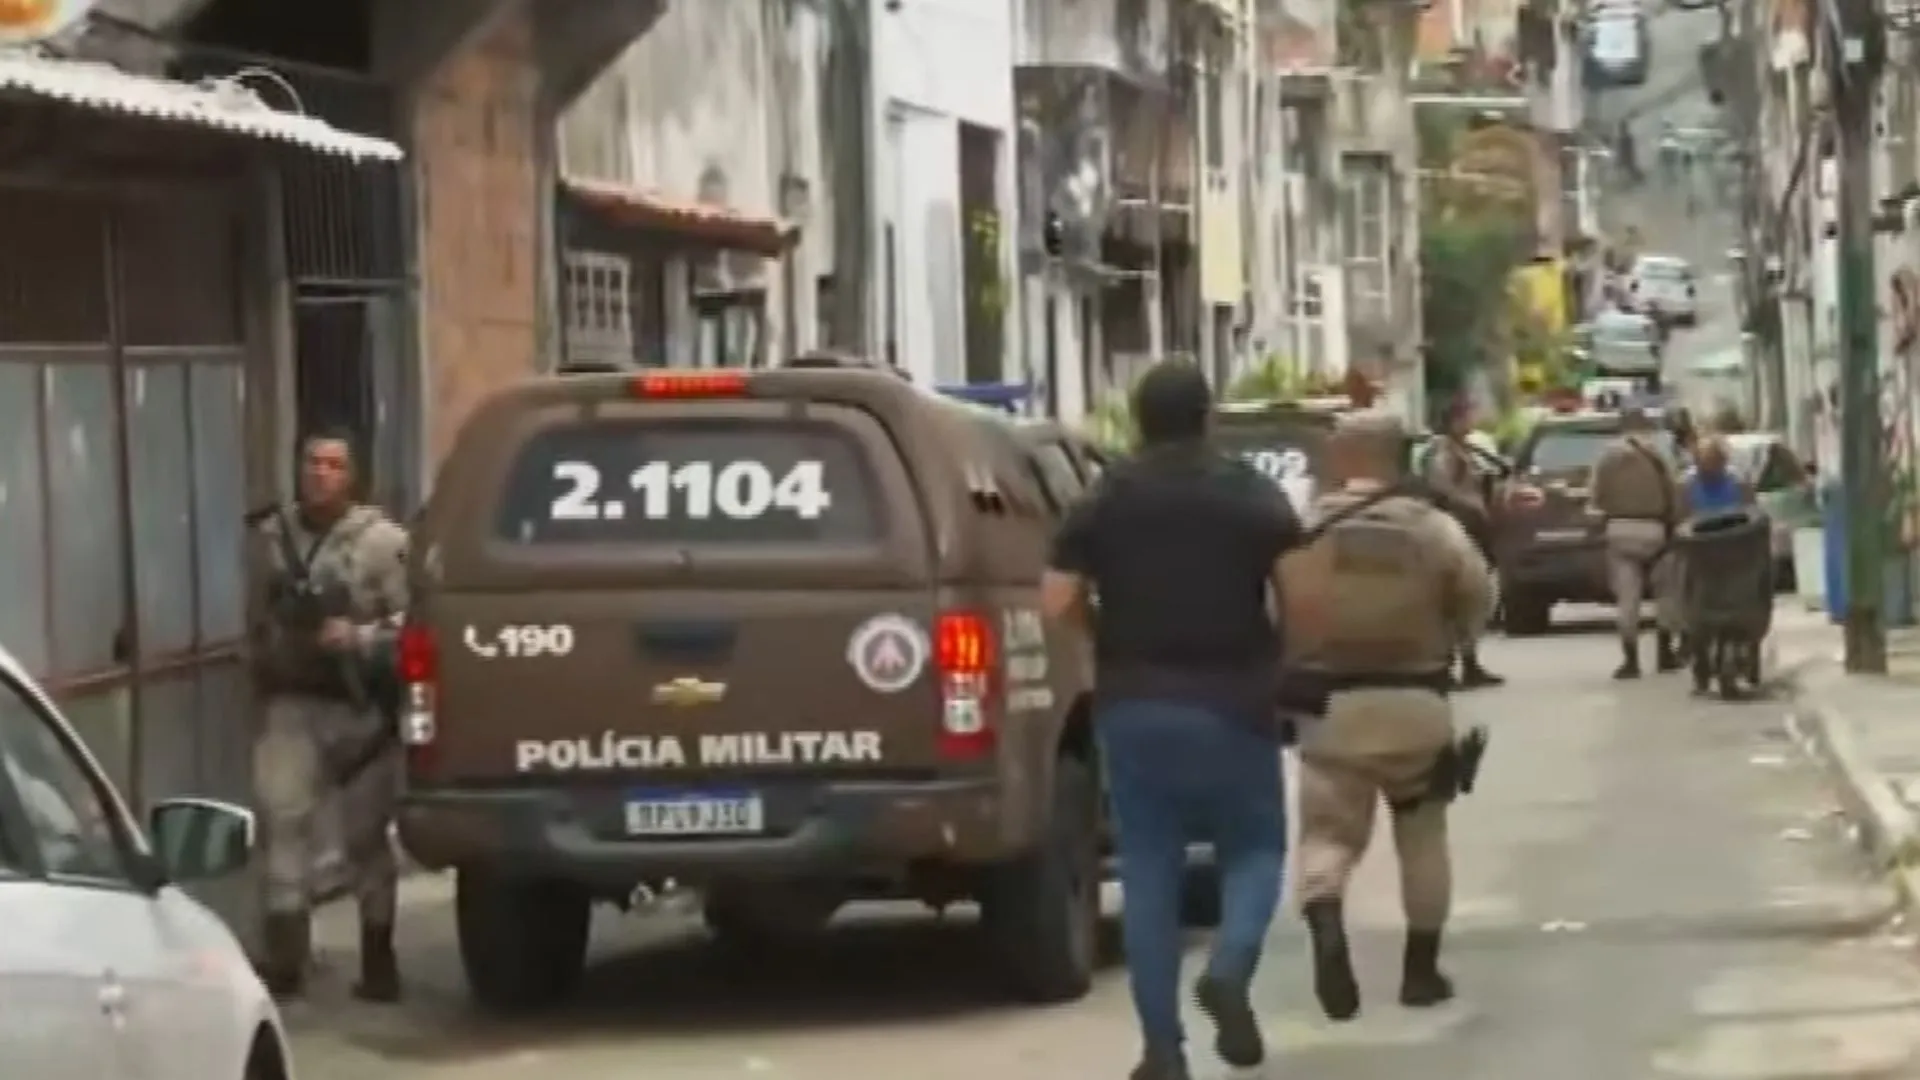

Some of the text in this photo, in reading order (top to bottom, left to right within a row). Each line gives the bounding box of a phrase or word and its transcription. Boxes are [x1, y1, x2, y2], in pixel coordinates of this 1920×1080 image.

[550, 460, 831, 519] 2.1104
[497, 624, 575, 657] 190
[516, 730, 883, 772] POLÍCIA MILITAR
